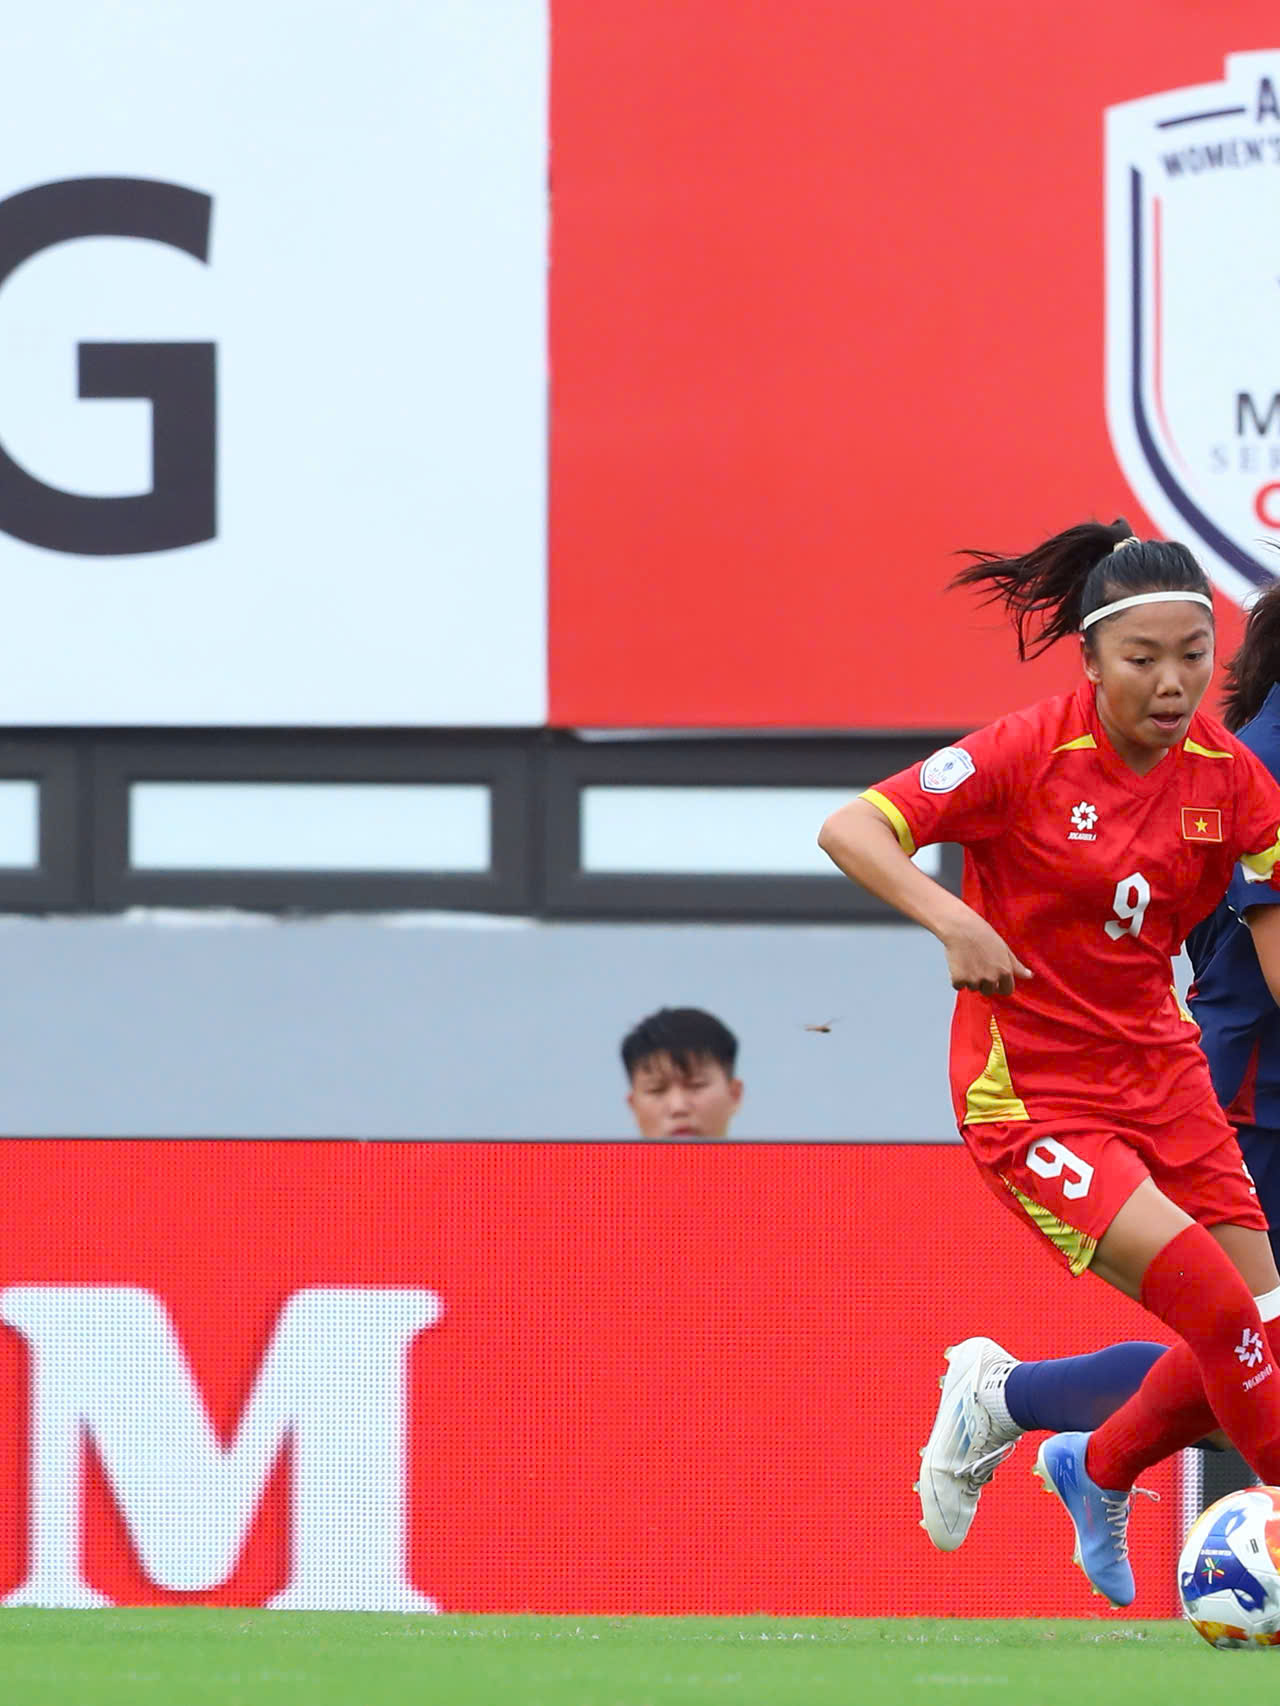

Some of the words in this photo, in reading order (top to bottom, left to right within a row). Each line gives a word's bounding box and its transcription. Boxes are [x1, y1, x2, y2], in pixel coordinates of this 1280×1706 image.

[1104, 872, 1151, 941] 9
[1025, 1135, 1095, 1201] 9
[0, 1284, 445, 1614] M
